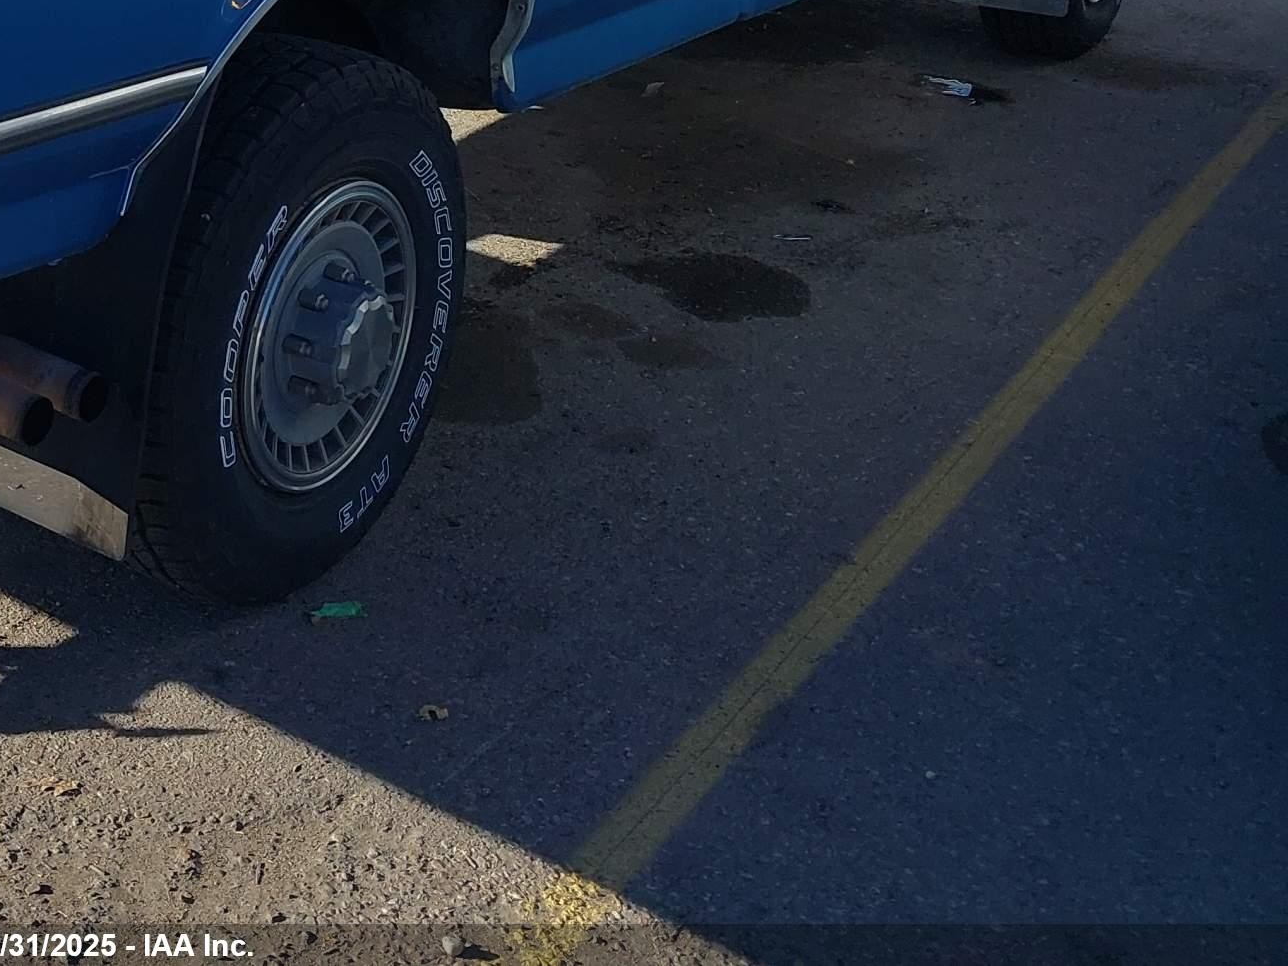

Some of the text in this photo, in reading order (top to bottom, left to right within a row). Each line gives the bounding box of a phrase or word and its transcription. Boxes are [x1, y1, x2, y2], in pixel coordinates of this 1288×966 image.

[219, 205, 288, 468] COOPER
[338, 150, 454, 534] DISCOVERER AT3
